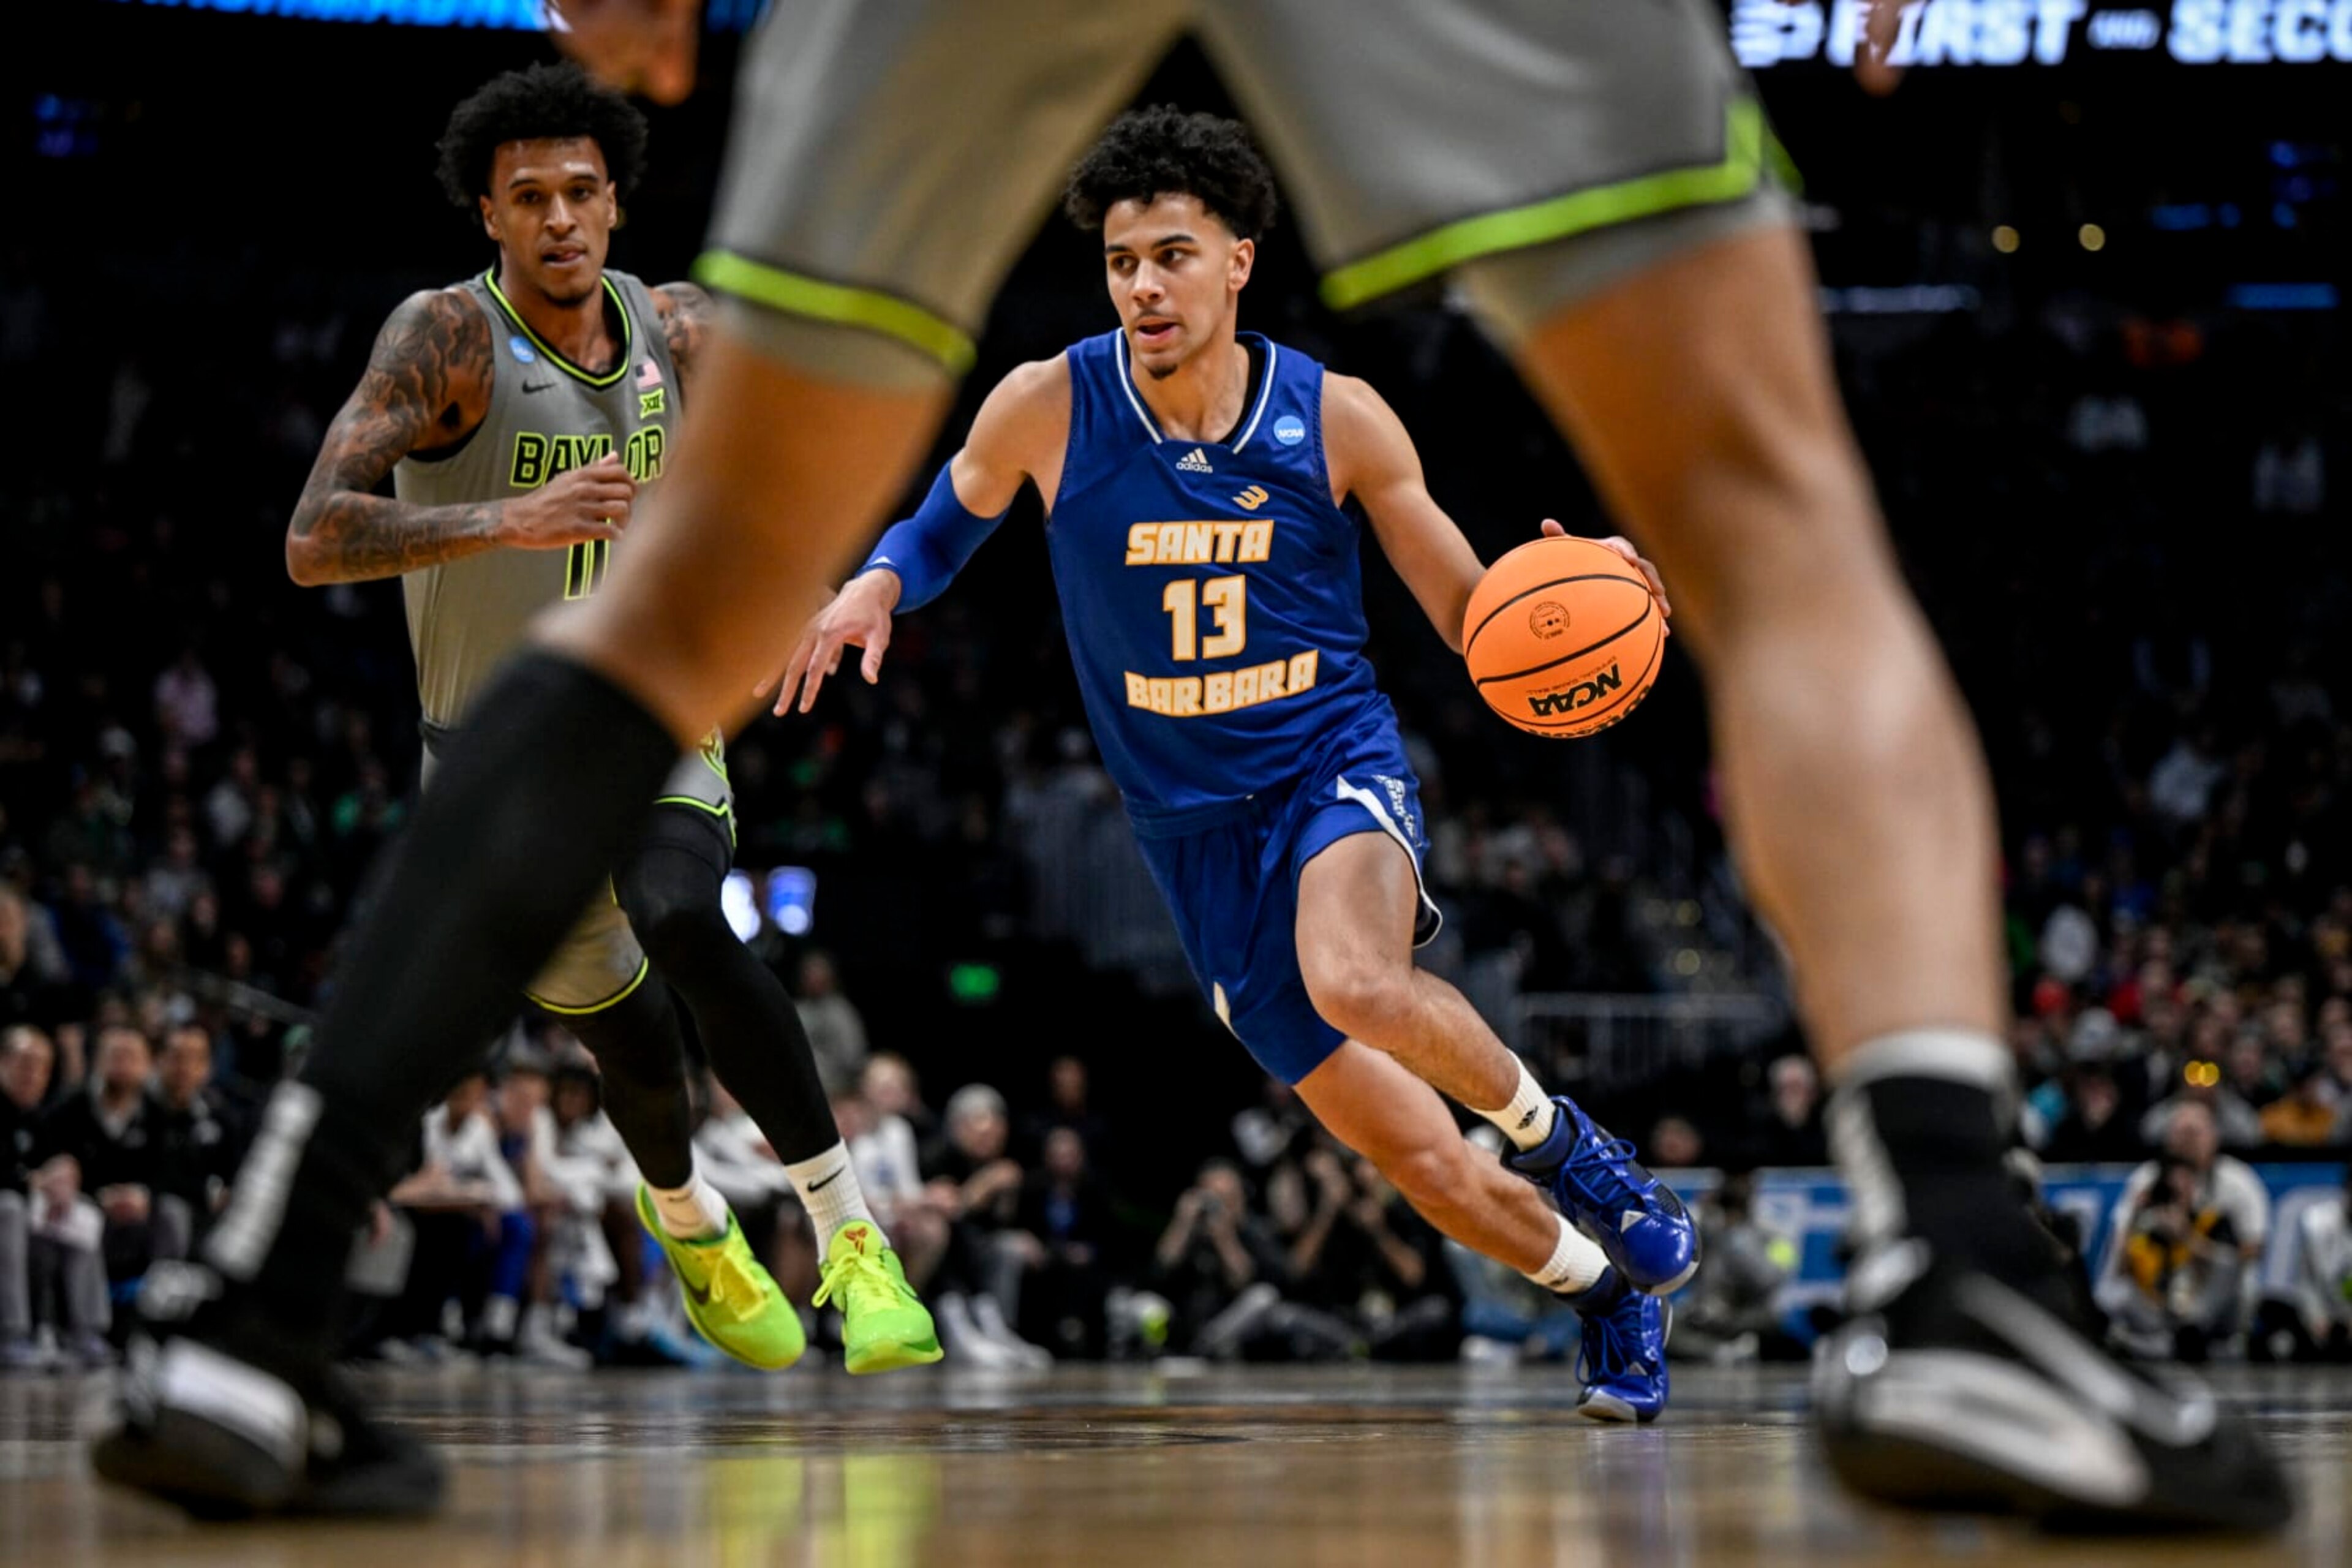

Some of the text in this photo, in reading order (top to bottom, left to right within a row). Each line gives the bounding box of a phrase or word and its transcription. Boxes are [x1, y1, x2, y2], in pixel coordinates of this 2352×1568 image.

[1176, 461, 1213, 473] adidas
[1126, 519, 1274, 565] SANTA
[1163, 574, 1246, 662] 13
[1125, 649, 1319, 717] BARBARA
[1528, 663, 1622, 716] NCAA
